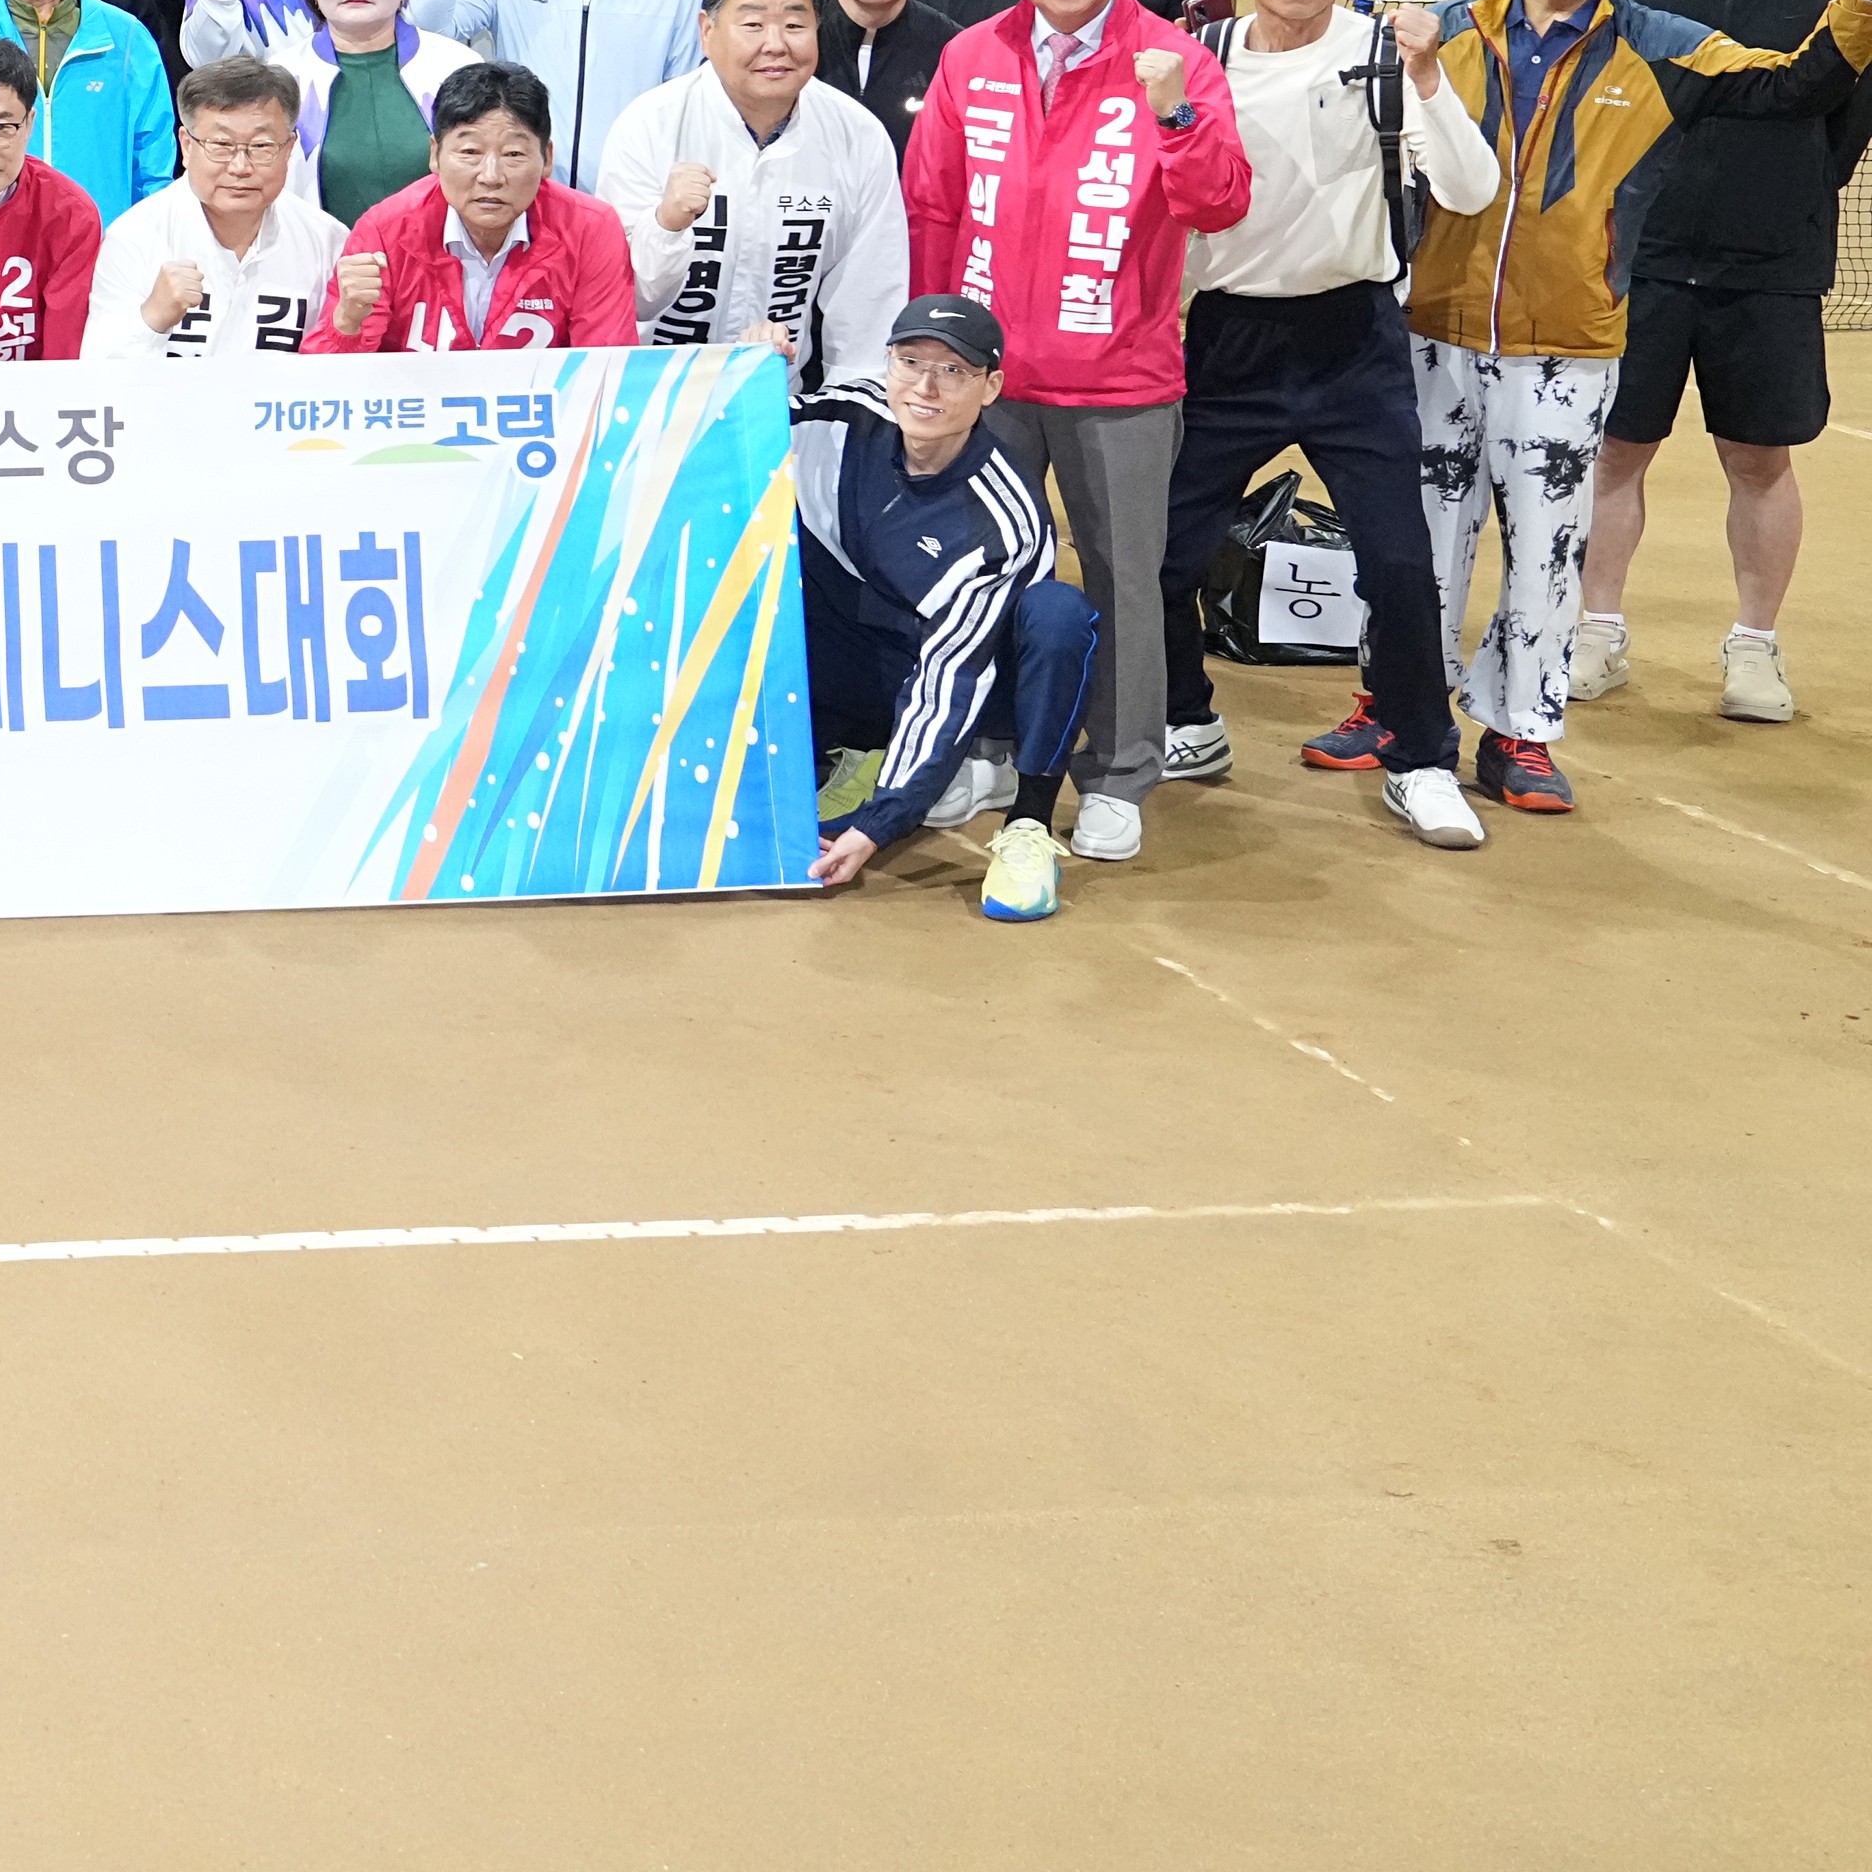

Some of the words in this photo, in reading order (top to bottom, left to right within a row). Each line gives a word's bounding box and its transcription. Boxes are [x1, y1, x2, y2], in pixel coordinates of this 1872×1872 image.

[777, 195, 833, 214] 무소속
[0, 256, 33, 309] 2
[256, 295, 307, 353] 김
[254, 400, 353, 431] 가야가
[432, 394, 557, 478] 고령
[1274, 562, 1341, 620] 농
